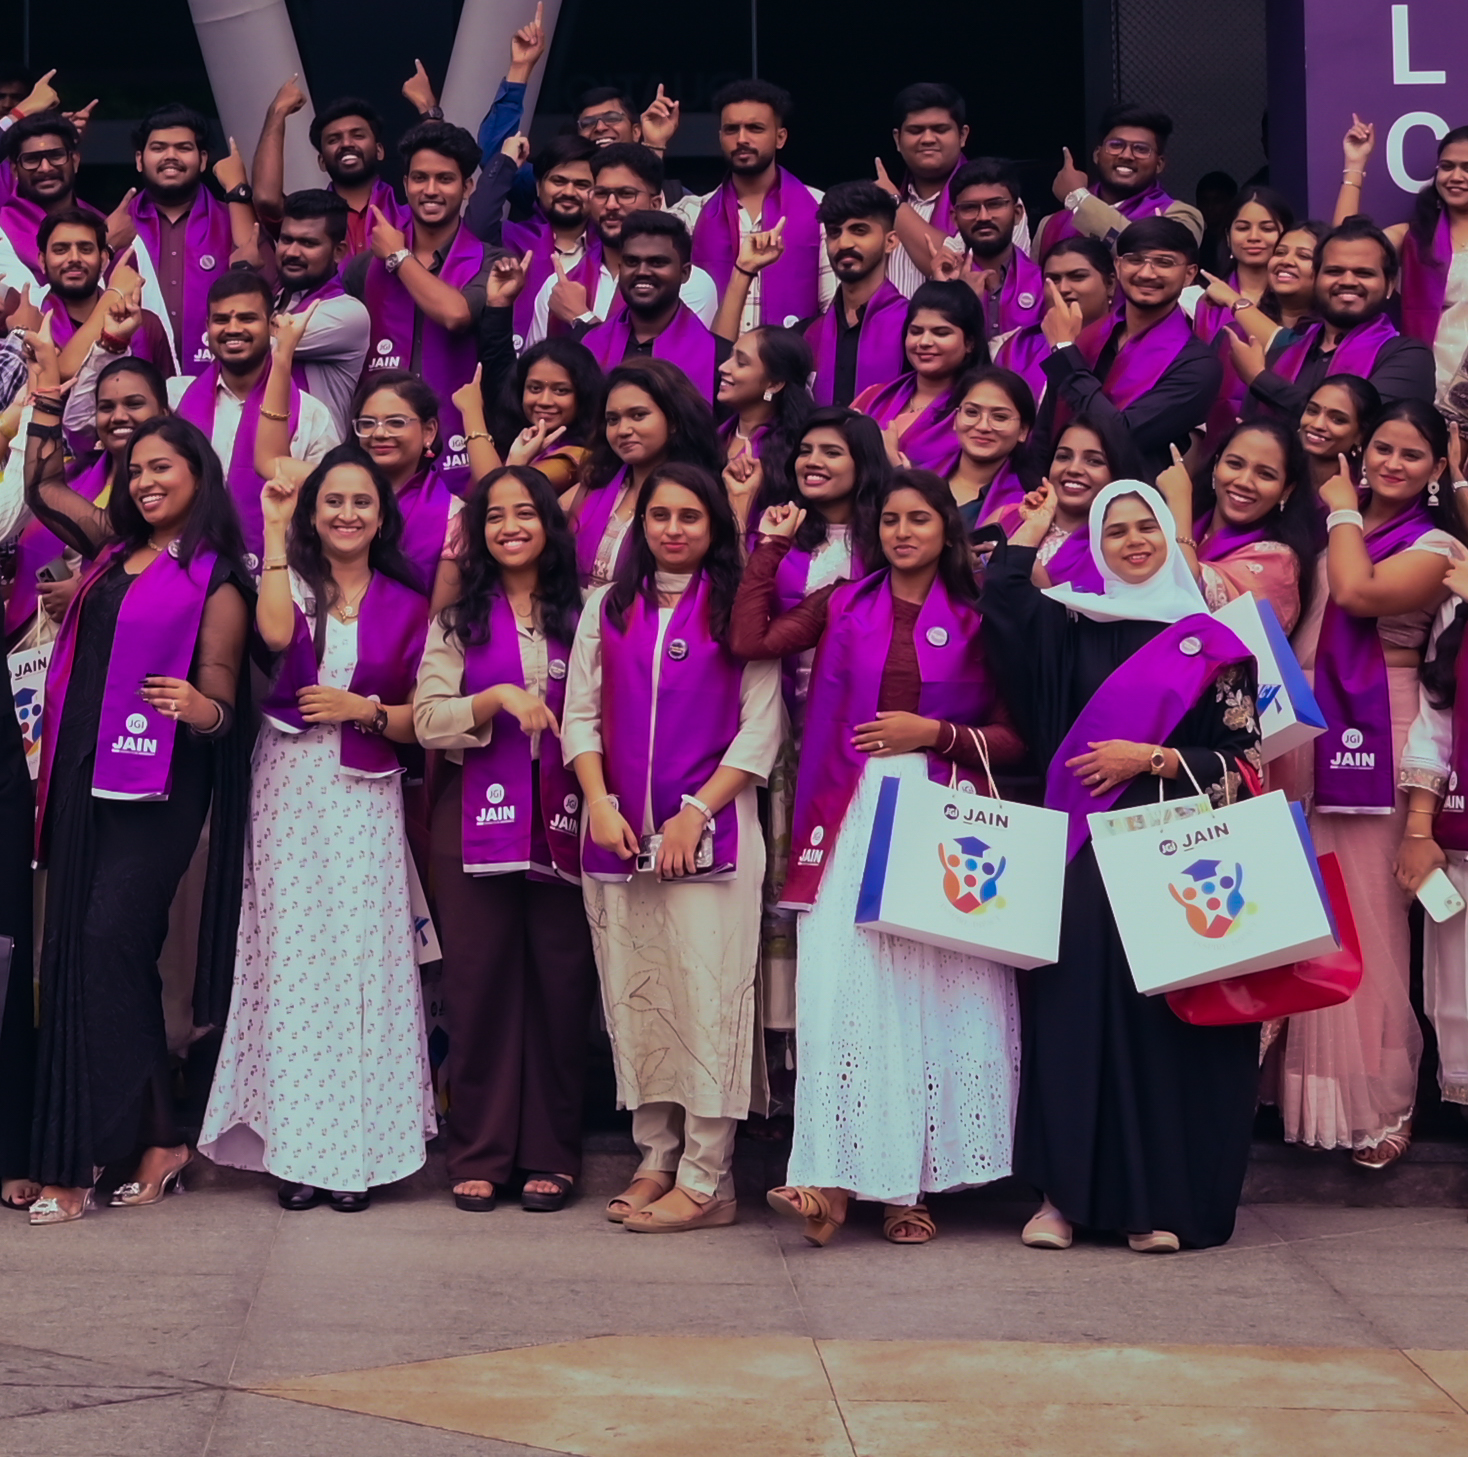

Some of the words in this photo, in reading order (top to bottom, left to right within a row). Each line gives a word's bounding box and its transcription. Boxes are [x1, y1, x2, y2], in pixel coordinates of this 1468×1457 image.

[193, 349, 214, 361] JA
[368, 356, 401, 370] JAIN
[442, 453, 469, 469] JAI
[14, 656, 47, 677] JAIN
[112, 736, 159, 754] JAIN
[1330, 752, 1375, 767] JAIN
[1444, 795, 1465, 810] AIN
[475, 806, 515, 823] JAIN
[963, 808, 1010, 828] JAIN
[1182, 823, 1231, 848] JAIN
[799, 848, 824, 864] JAIN
